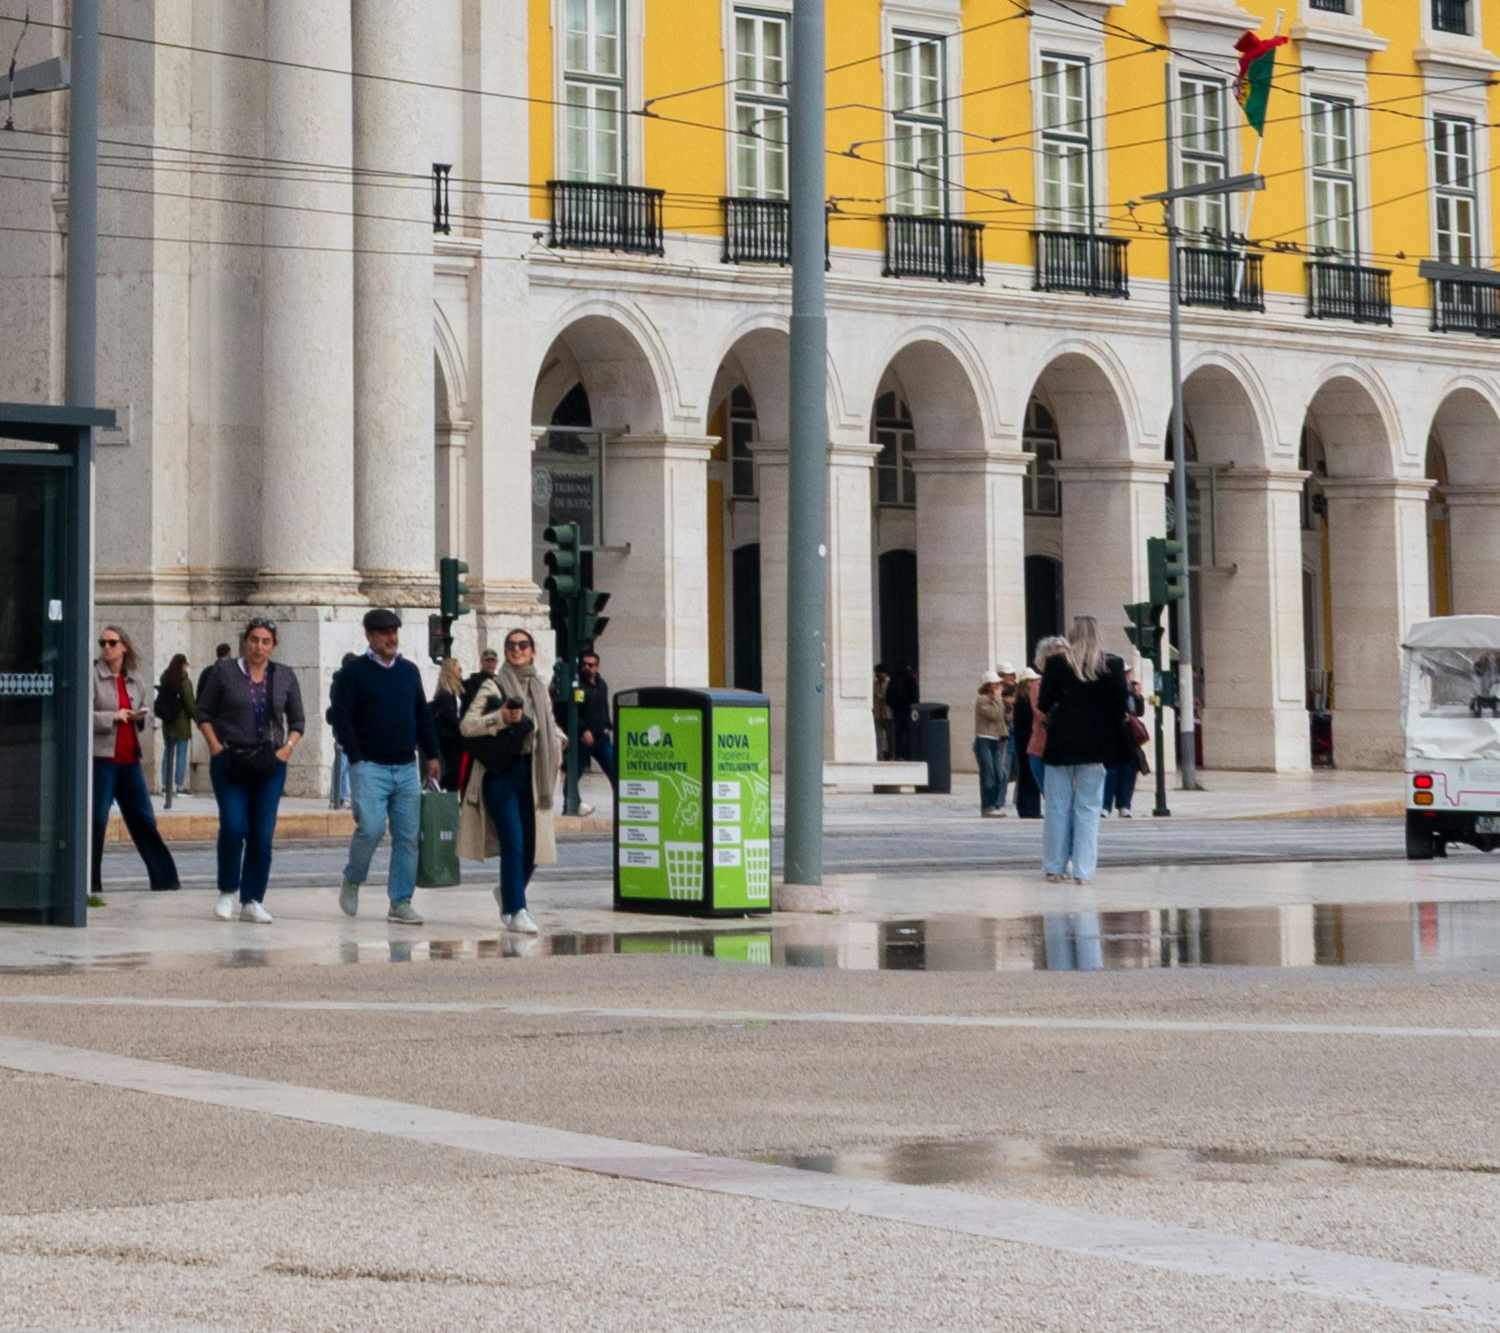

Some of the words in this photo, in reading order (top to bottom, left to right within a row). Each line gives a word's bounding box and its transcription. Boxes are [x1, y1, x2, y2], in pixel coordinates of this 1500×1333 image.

[555, 483, 592, 493] TRIBUNAL
[718, 735, 748, 748] NOVA
[627, 749, 674, 760] Papeleira
[627, 761, 687, 771] INTELIGENTE
[718, 762, 758, 771] INTELIGENTE
